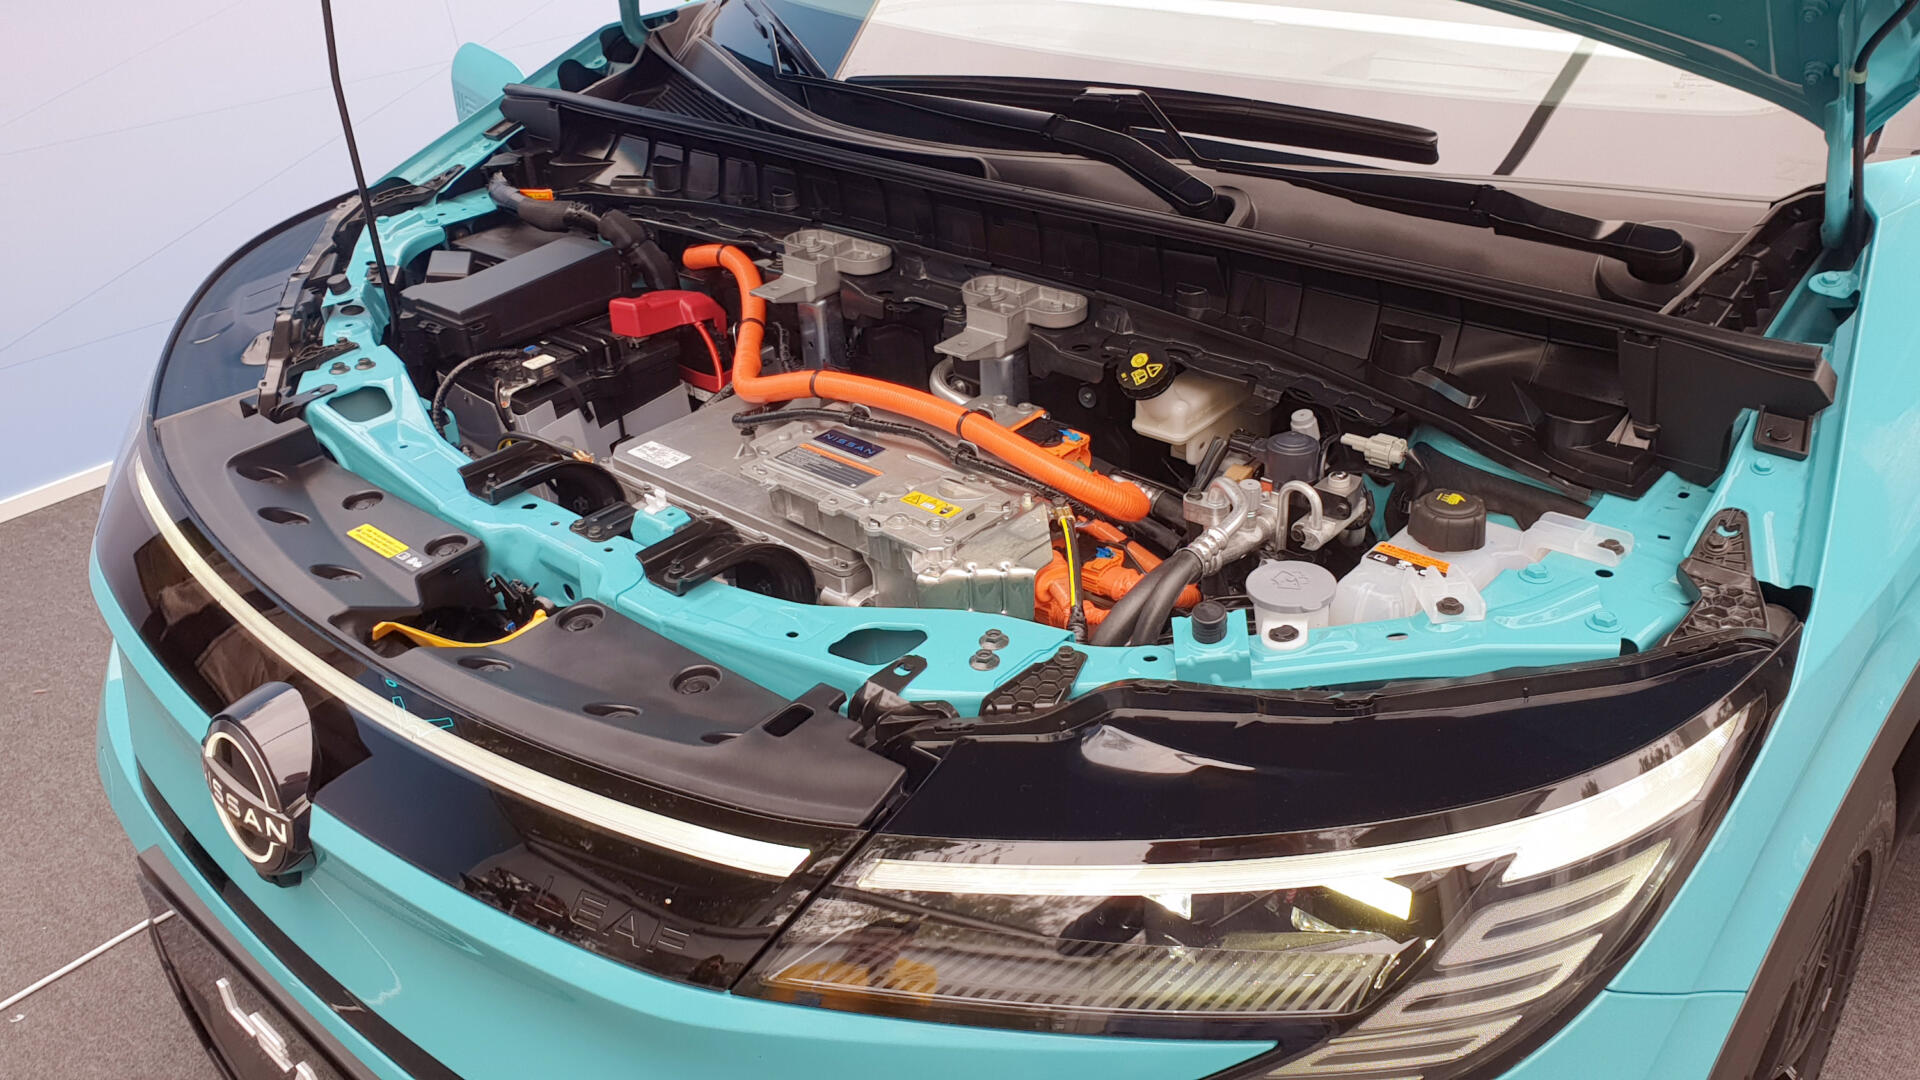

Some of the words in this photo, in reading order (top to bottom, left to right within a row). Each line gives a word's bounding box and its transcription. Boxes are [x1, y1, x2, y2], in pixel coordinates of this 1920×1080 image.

[823, 432, 876, 456] NISSAN
[204, 769, 288, 844] ISSAN
[534, 875, 690, 953] LEAF
